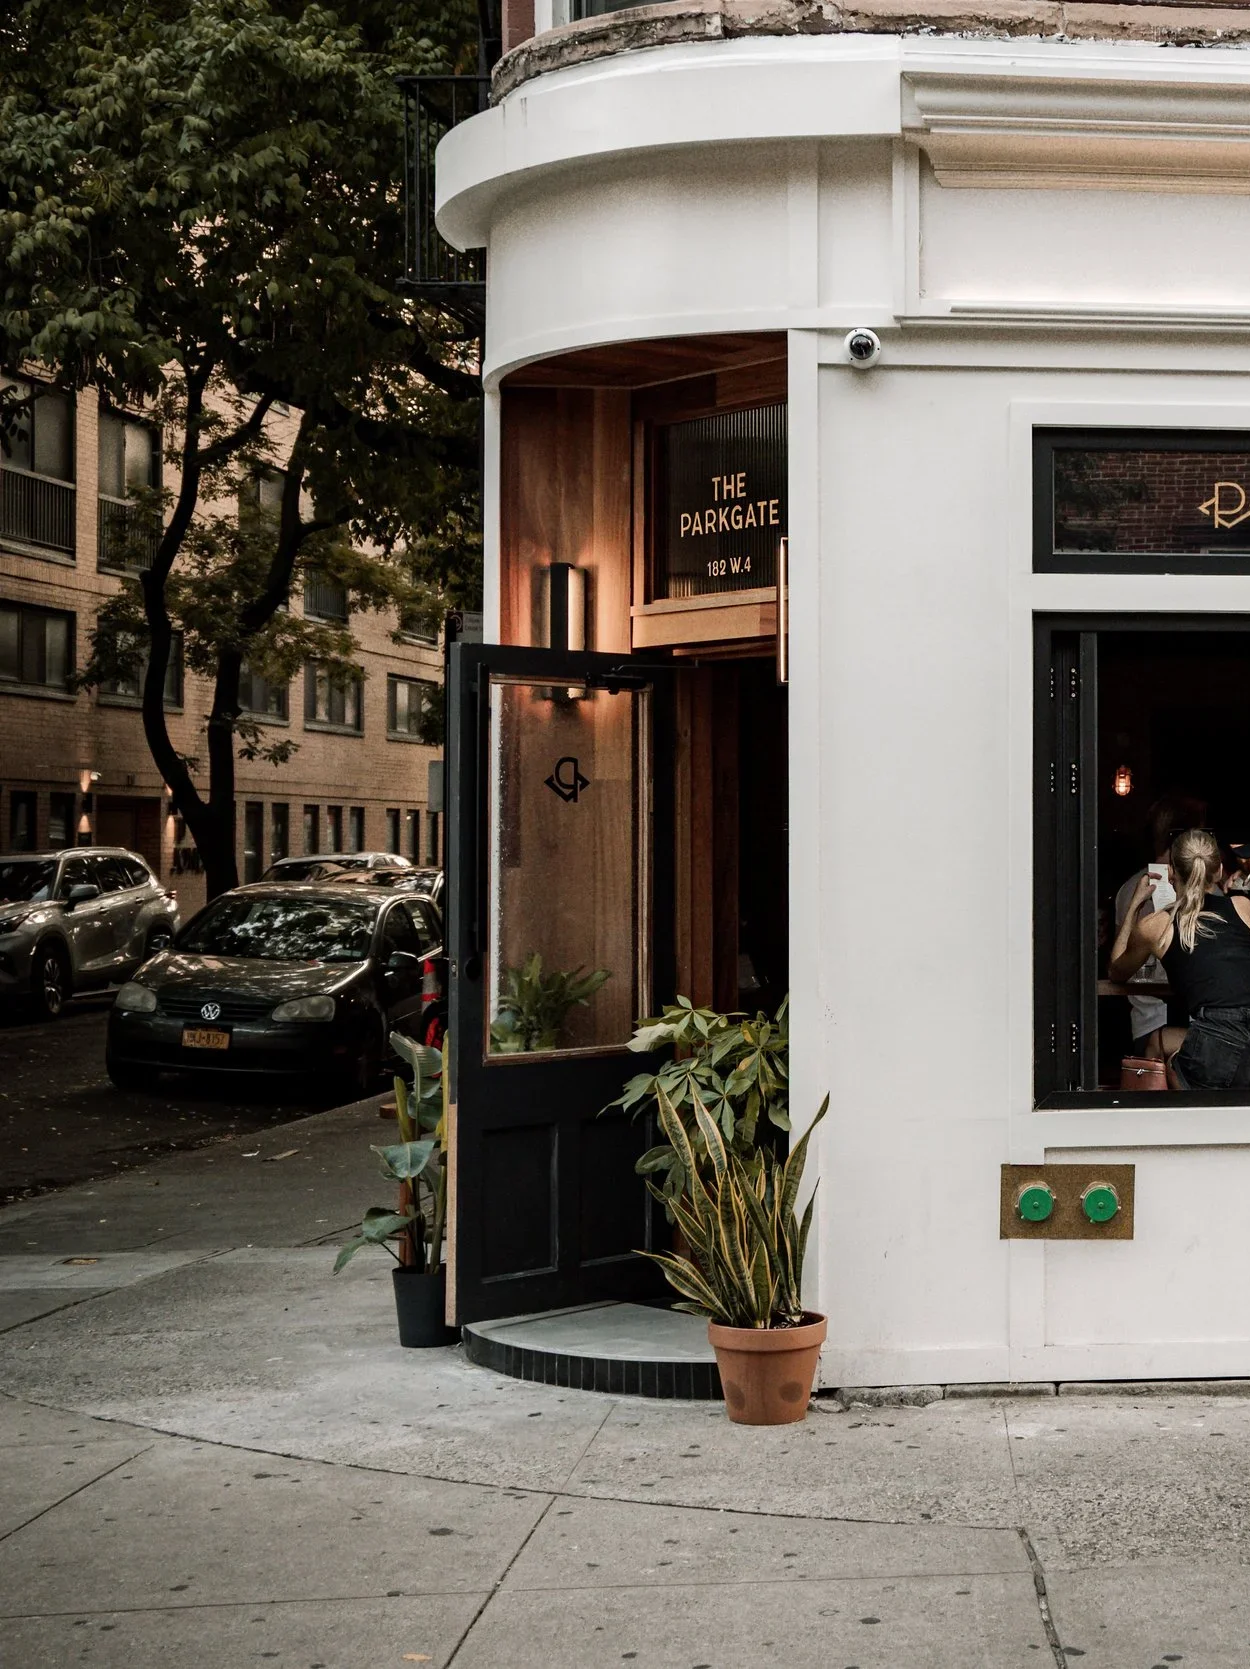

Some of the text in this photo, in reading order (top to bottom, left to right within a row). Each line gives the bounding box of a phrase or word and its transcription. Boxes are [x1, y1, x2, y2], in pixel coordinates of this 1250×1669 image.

[712, 472, 747, 501] THE
[680, 499, 780, 538] PARKGATE
[707, 556, 752, 577] 182 W.4
